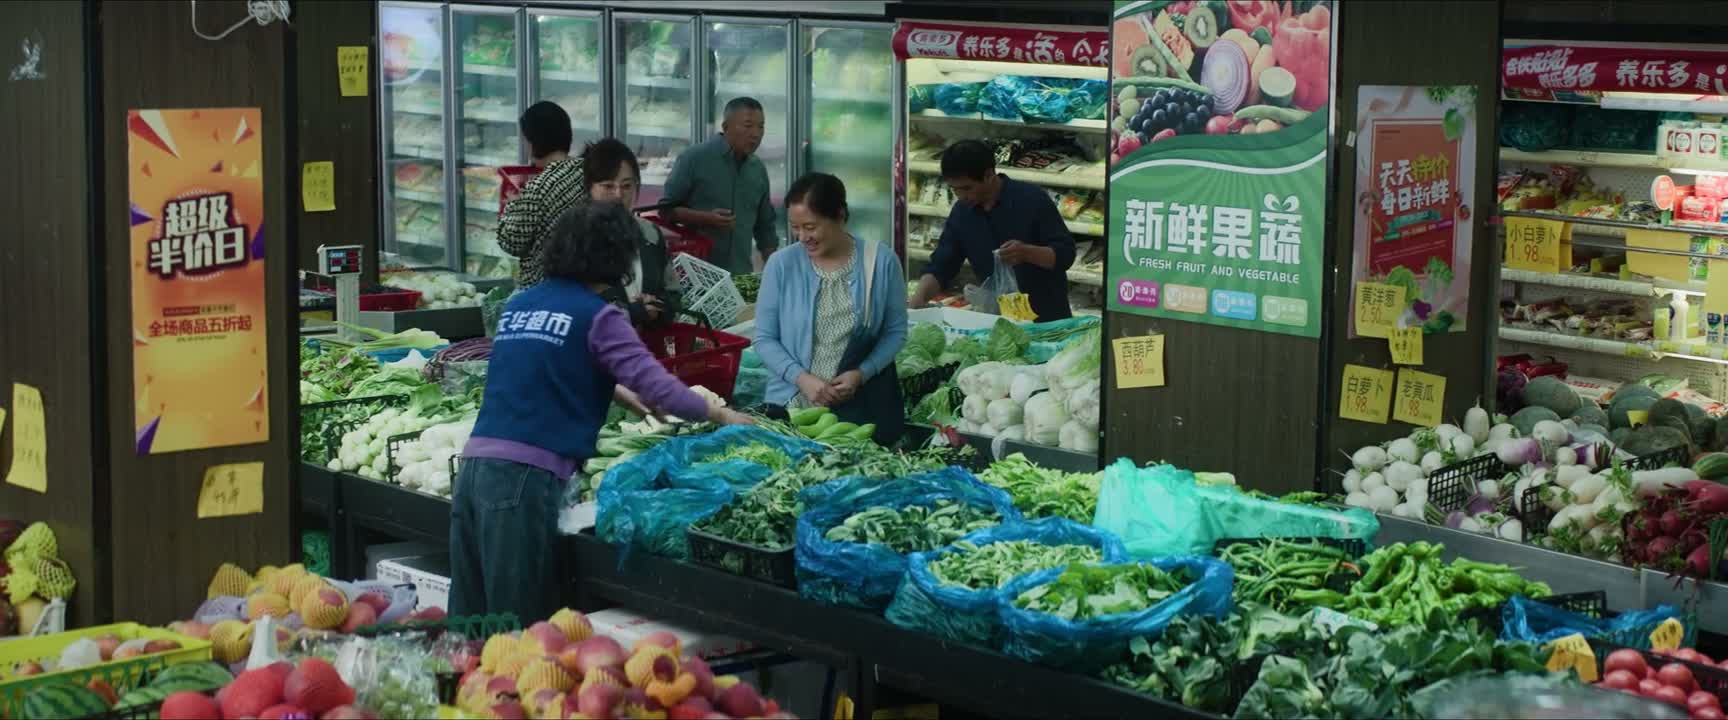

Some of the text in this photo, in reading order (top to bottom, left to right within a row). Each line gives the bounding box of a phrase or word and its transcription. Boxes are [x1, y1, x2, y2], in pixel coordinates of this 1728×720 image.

[1379, 152, 1449, 188] 天天特价
[1380, 178, 1450, 216] 每日新鲜
[165, 195, 230, 238] 超级
[1123, 194, 1303, 266] 新鲜果蔬
[1510, 223, 1557, 245] 小白萝卜
[150, 226, 245, 274] 半价日
[1510, 243, 1538, 262] 1.98
[1139, 257, 1300, 285] FRESH FRUIT AND VEGETABLE
[1361, 287, 1396, 308] 黄洋葱
[148, 315, 253, 337] 全场商品五折起
[1120, 338, 1156, 359] 西葫芦
[1347, 376, 1384, 397] 白萝卜
[1403, 381, 1435, 404] 老黄瓜
